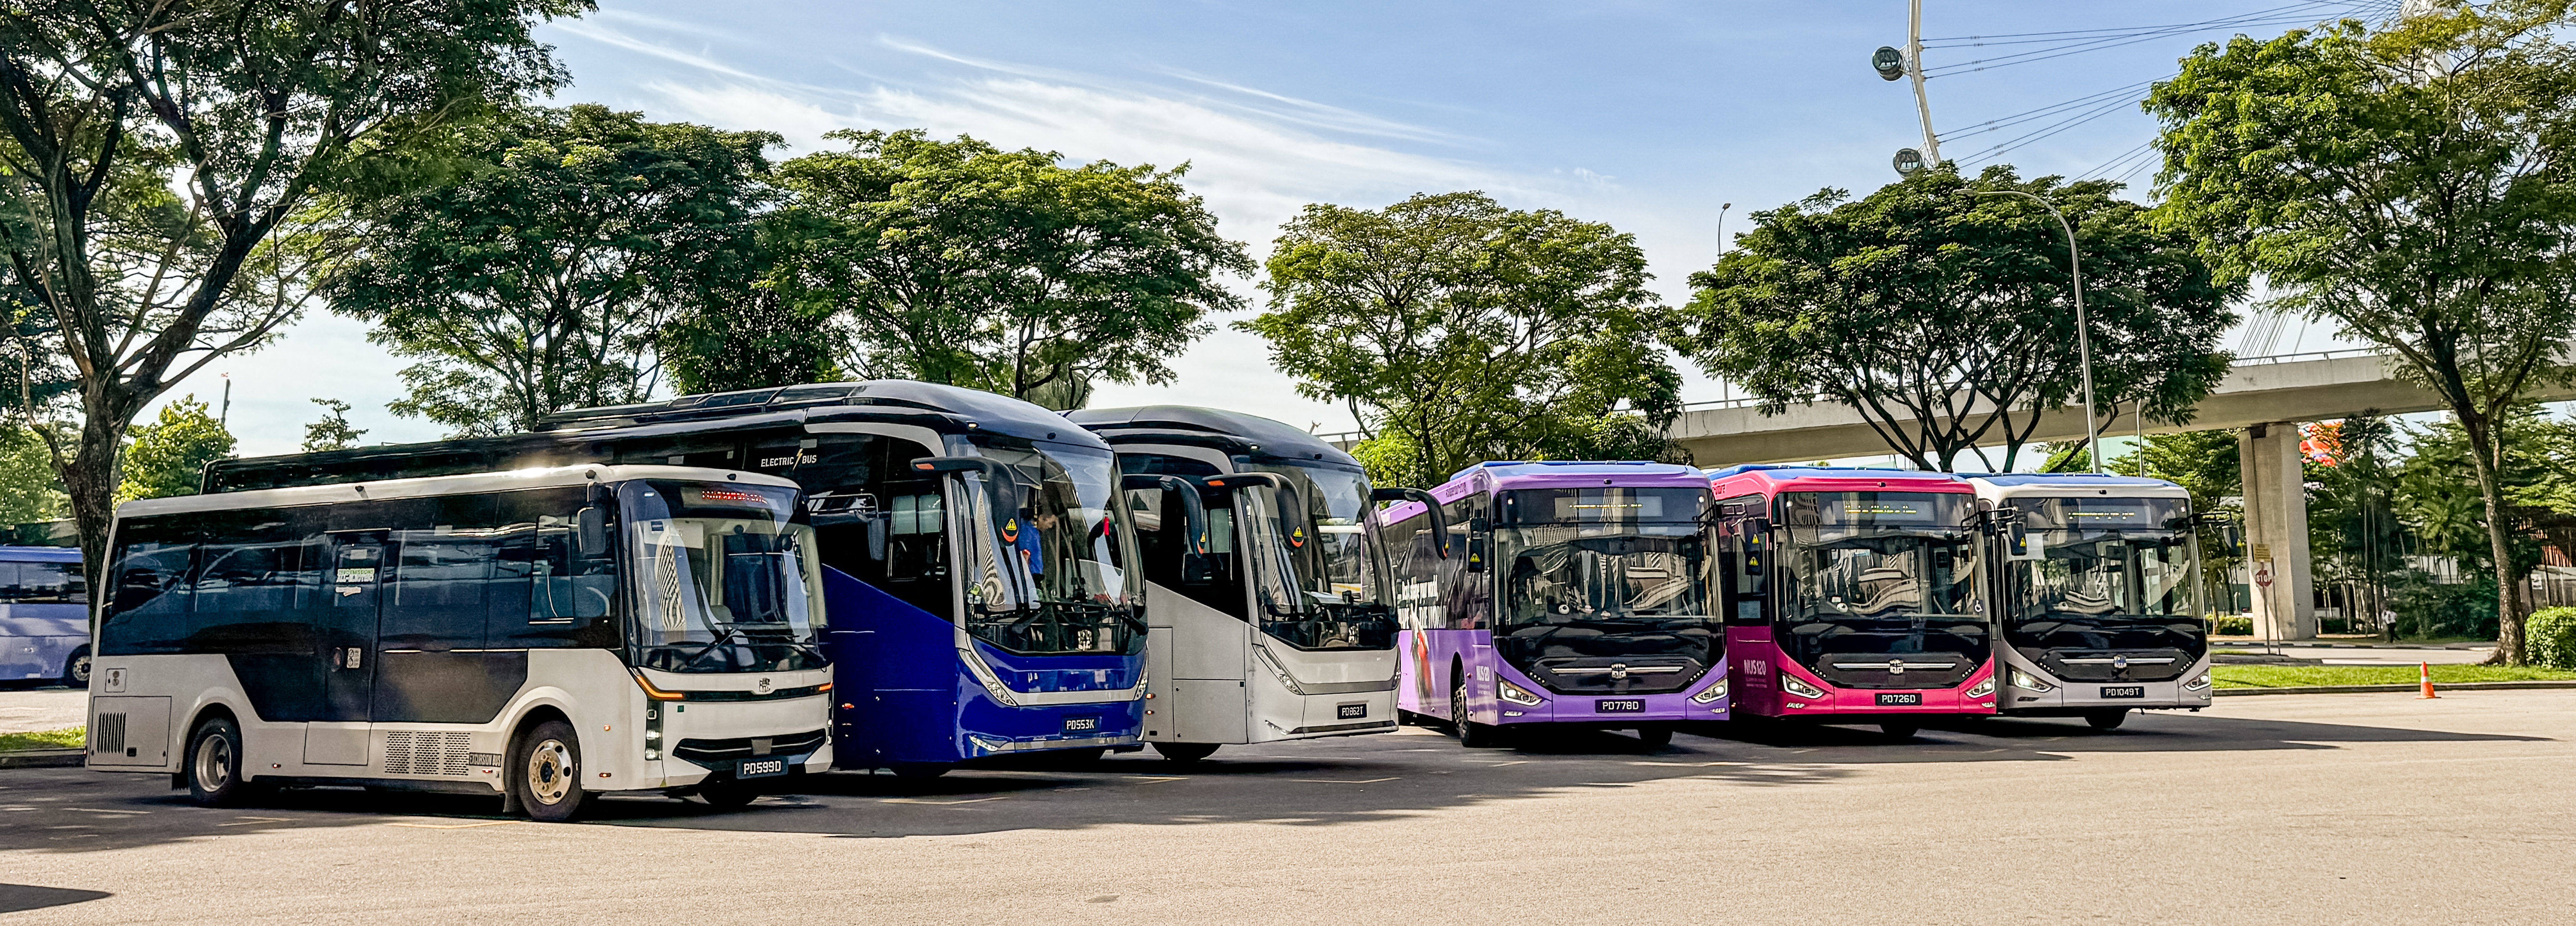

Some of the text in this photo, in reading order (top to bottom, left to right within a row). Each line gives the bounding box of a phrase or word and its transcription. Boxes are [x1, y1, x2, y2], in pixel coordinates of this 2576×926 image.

[761, 455, 817, 467] ELECTRIC BUS
[2105, 688, 2139, 696] PD1049T
[1882, 695, 1916, 703] PD726D
[1602, 701, 1639, 709] PD778D
[1342, 706, 1363, 716] PD862T
[1066, 719, 1094, 730] PD553K
[743, 760, 781, 775] PD599D
